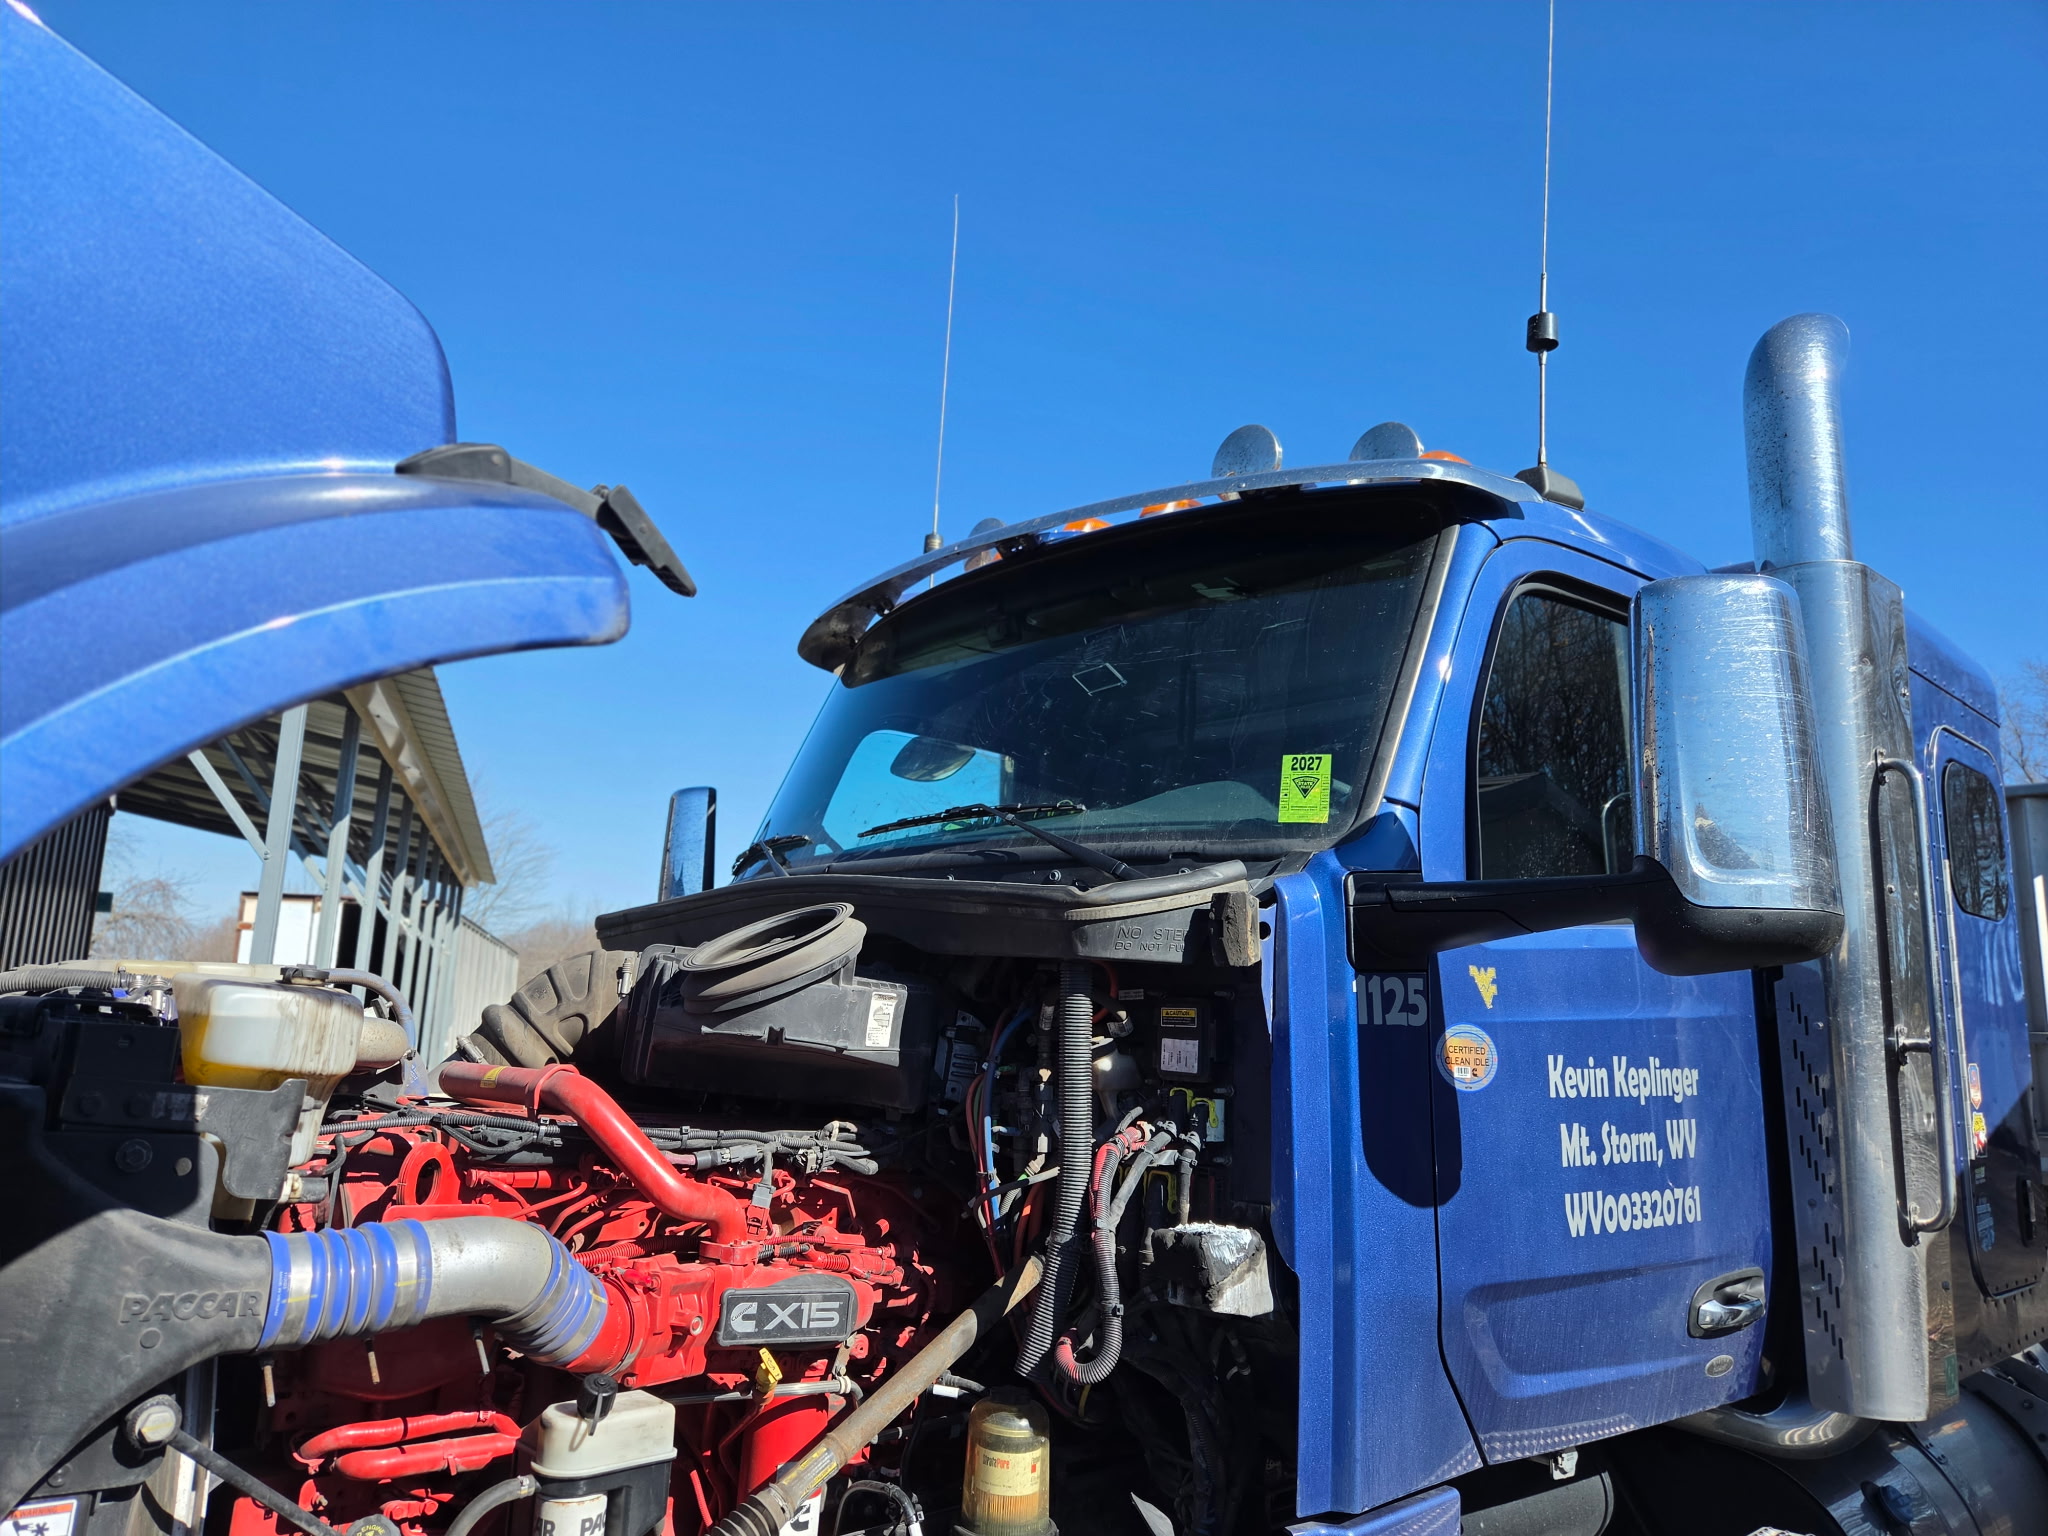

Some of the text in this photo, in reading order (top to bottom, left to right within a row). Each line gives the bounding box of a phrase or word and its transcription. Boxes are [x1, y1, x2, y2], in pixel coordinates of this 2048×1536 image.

[1291, 756, 1323, 771] 2027
[1114, 941, 1132, 951] DO
[1139, 942, 1162, 952] NOT
[1117, 926, 1142, 940] NO
[1352, 974, 1428, 1027] 1125
[1444, 1056, 1490, 1067] CLEAN IDLE
[1447, 1045, 1486, 1055] CERTIFIED
[1548, 1055, 1699, 1105] Kevin Keplinger
[1560, 1118, 1697, 1168] Mt. Storm, WV
[1564, 1186, 1702, 1238] WV003320761
[119, 1289, 263, 1325] PACCAR
[763, 1302, 840, 1331] X15
